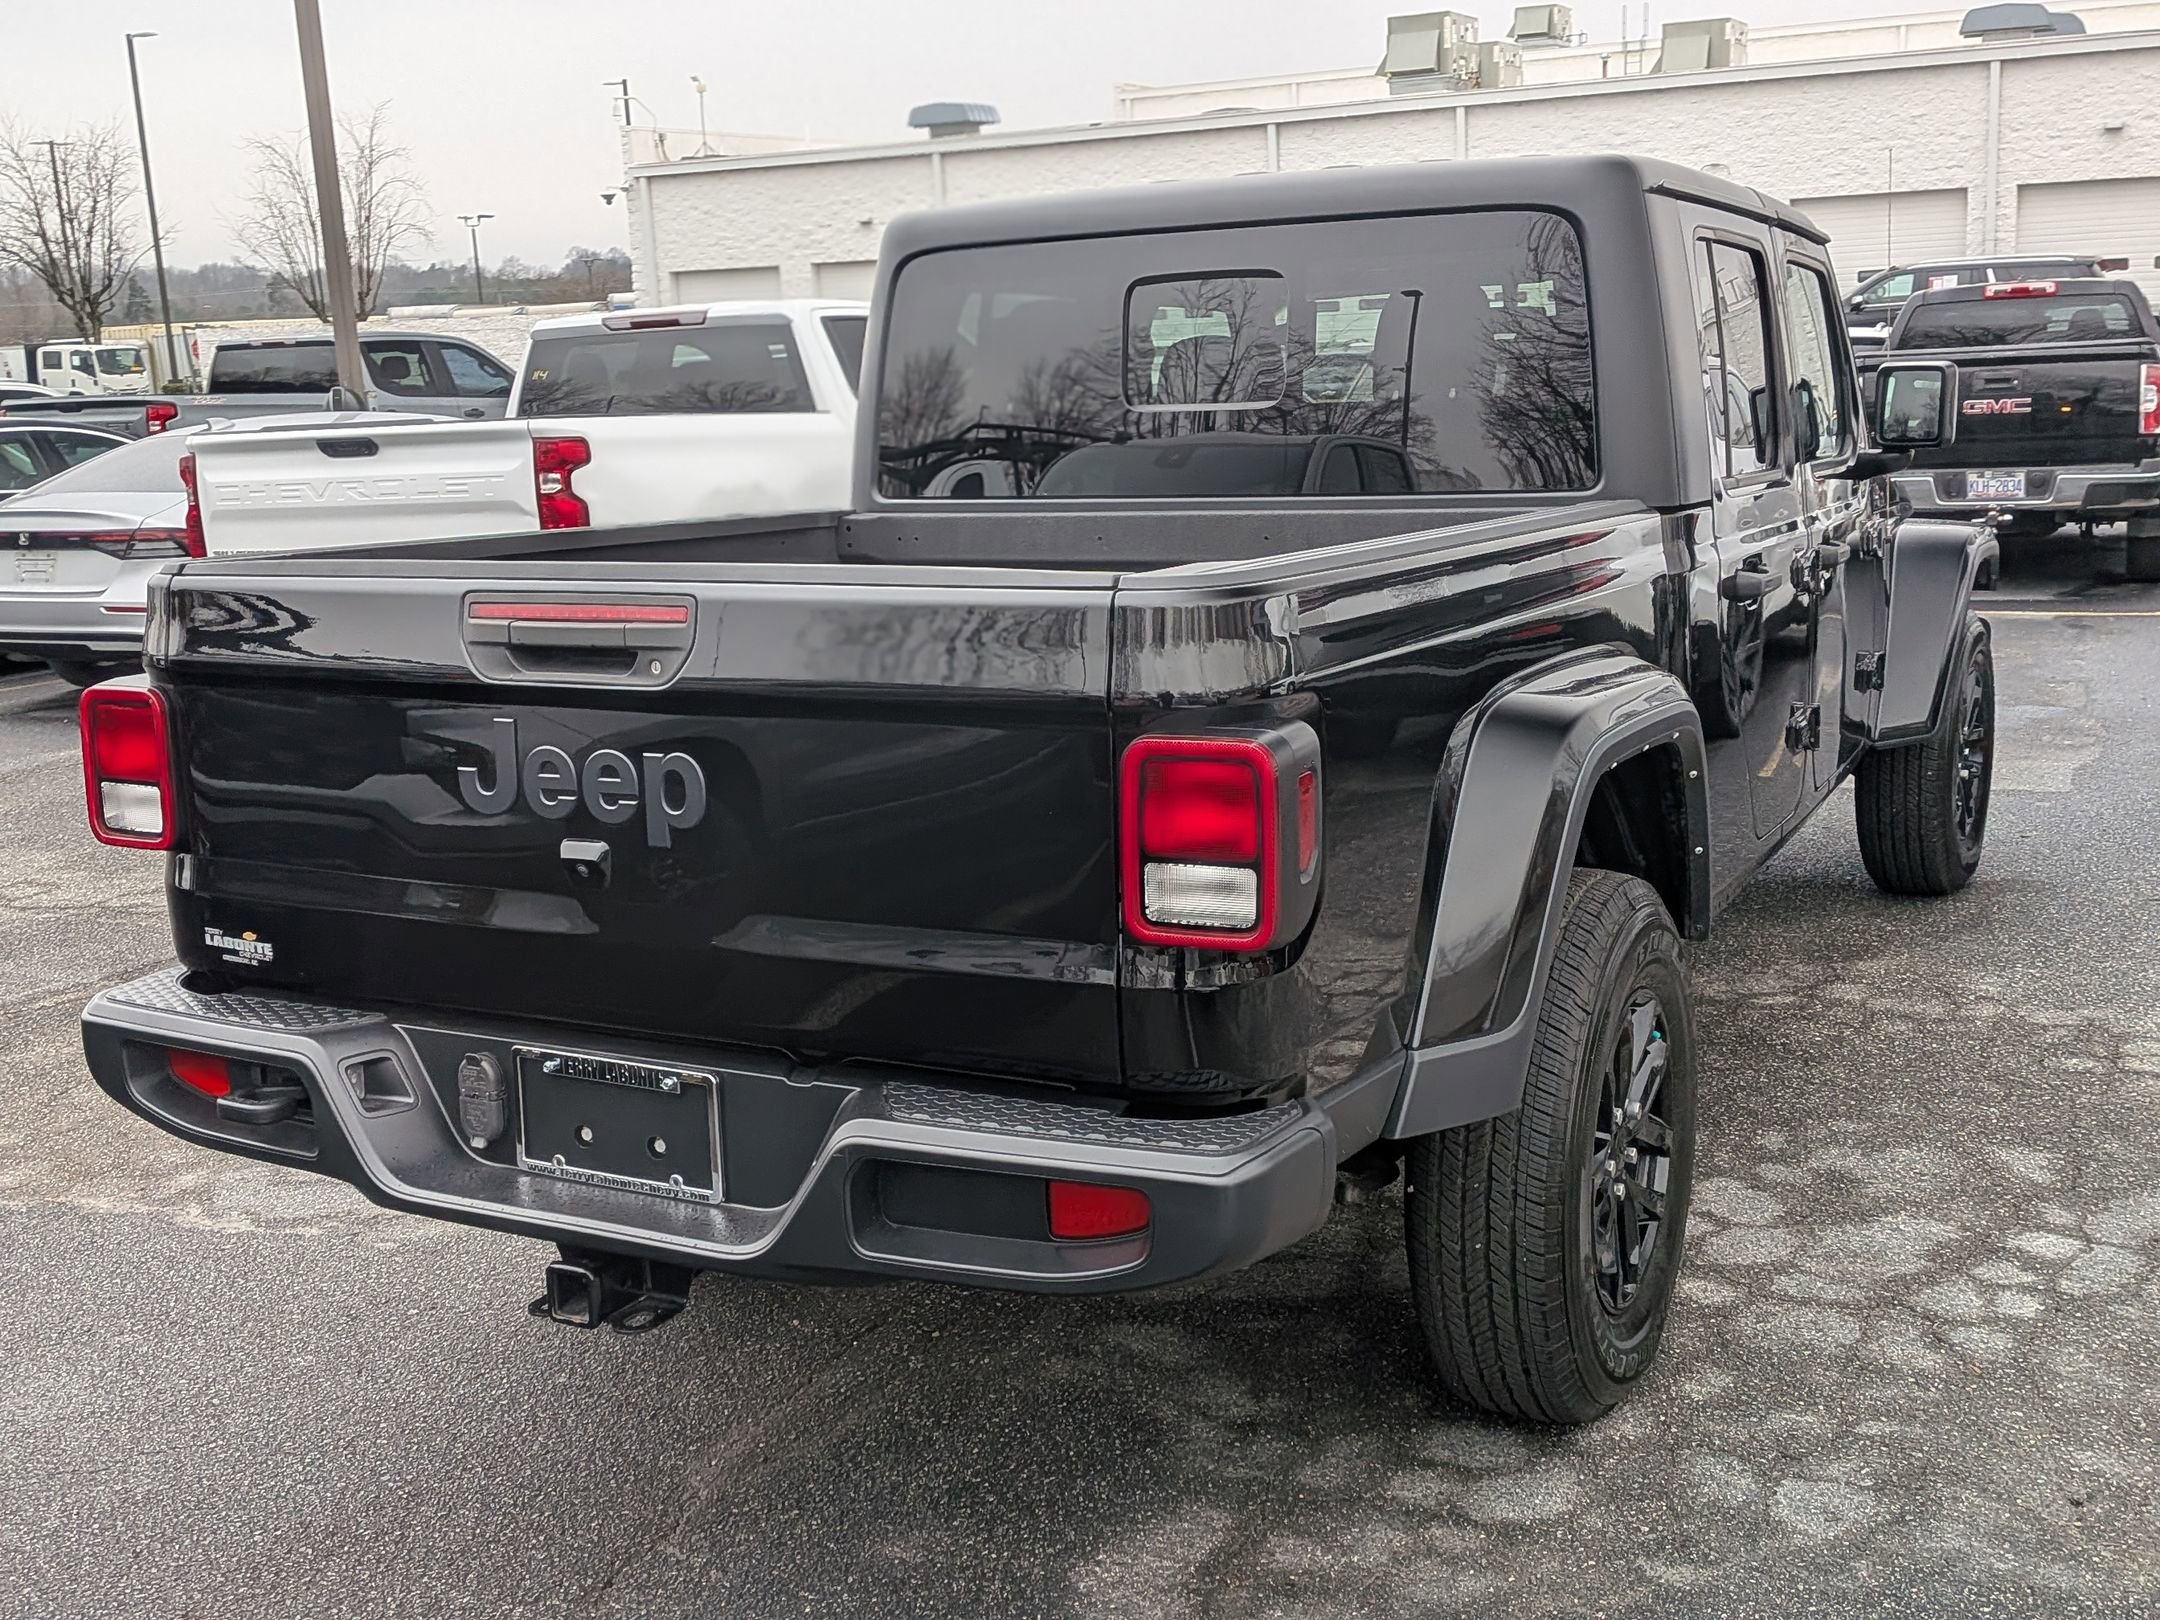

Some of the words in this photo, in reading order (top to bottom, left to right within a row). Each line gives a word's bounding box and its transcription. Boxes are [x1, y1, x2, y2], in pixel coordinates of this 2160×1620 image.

[1962, 397, 2032, 415] GMC
[214, 474, 504, 505] CHEVROLET
[457, 717, 706, 849] Jeep
[204, 933, 273, 956] LABONTE
